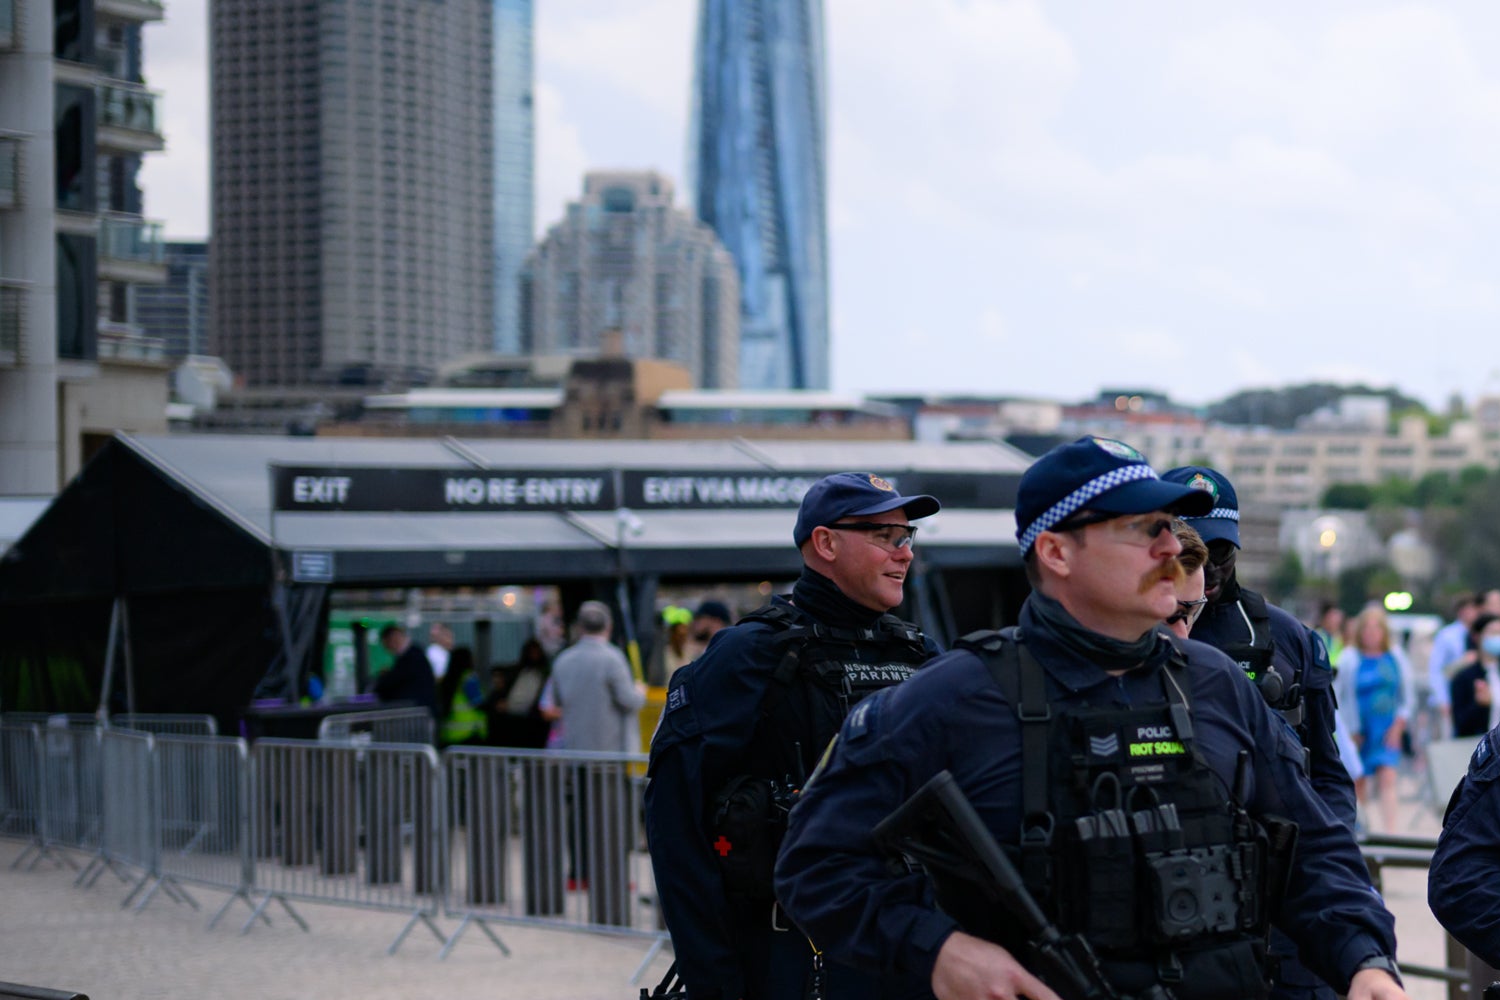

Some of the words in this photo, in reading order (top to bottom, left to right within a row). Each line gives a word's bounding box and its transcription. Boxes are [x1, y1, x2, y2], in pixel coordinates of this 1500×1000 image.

[294, 476, 351, 503] EXIT
[445, 478, 486, 504] NO
[487, 478, 603, 505] RE-ENTRY
[643, 476, 695, 504] EXIT
[697, 477, 734, 504] VIA
[1137, 726, 1172, 739] POLIC
[1129, 742, 1154, 756] RIOT
